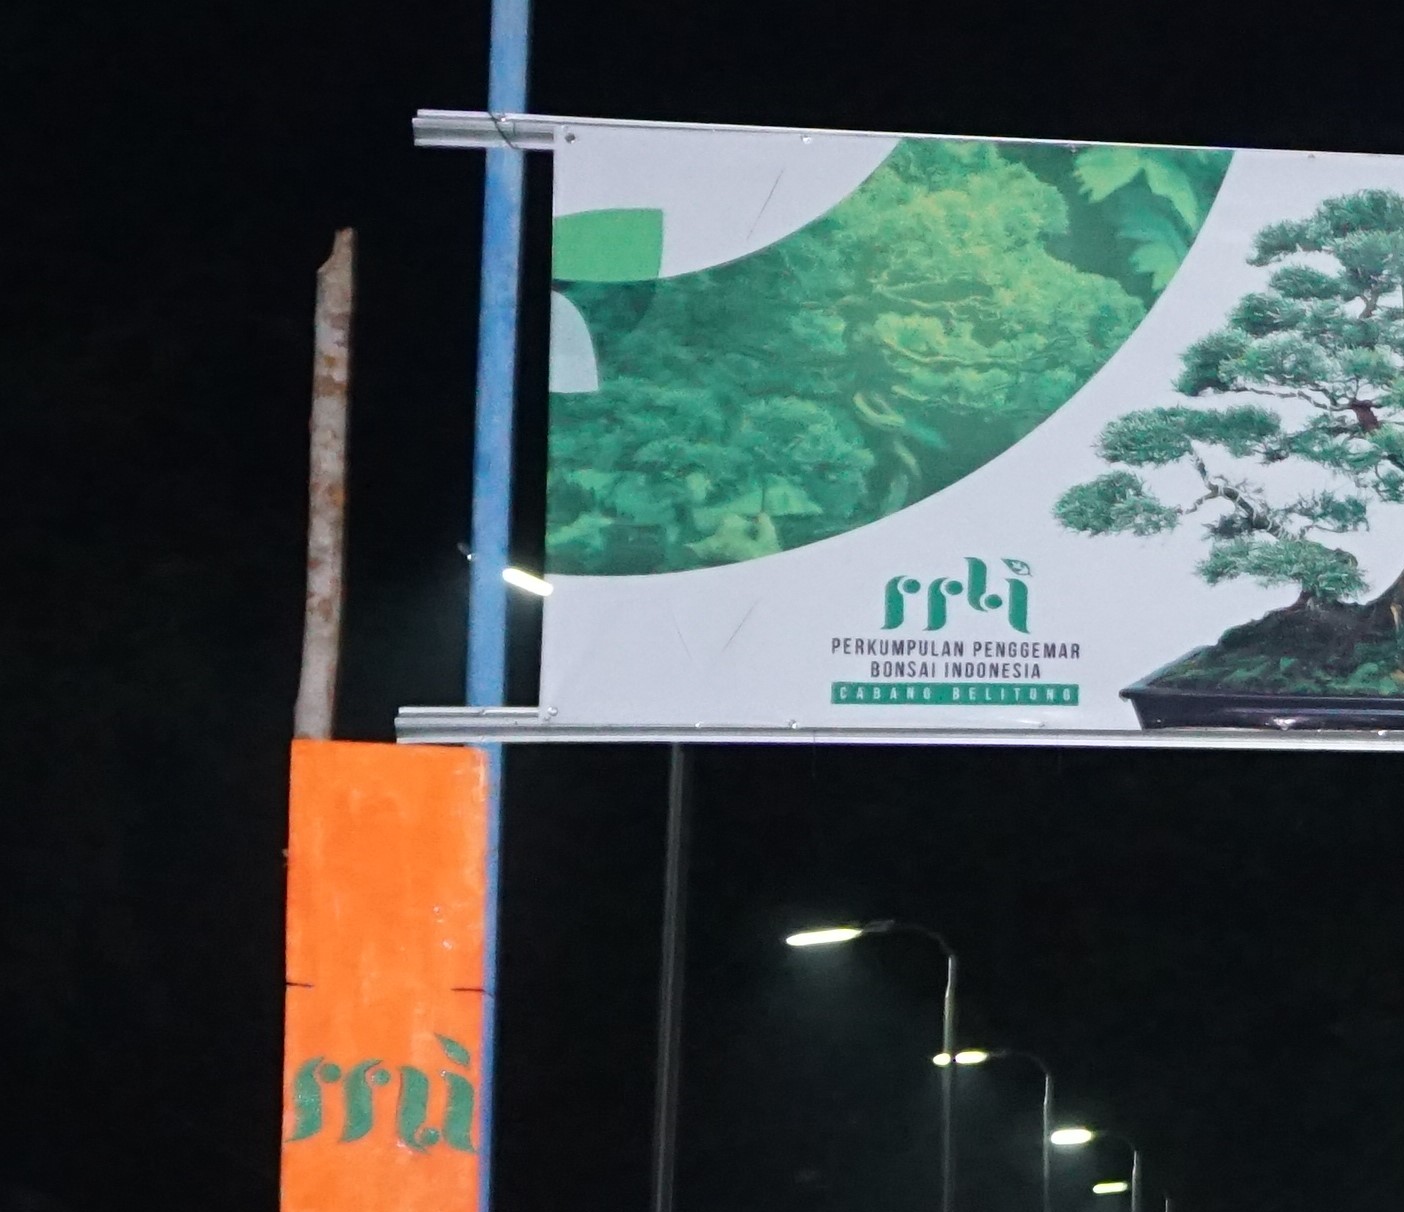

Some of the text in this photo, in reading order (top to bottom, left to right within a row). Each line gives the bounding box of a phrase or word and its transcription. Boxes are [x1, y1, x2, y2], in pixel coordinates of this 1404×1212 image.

[831, 637, 1081, 660] PERKUMPULAN PENGGEMAR
[870, 660, 1041, 680] BONSAI INDONESIA
[839, 686, 1071, 702] CABANG BELITUNG
